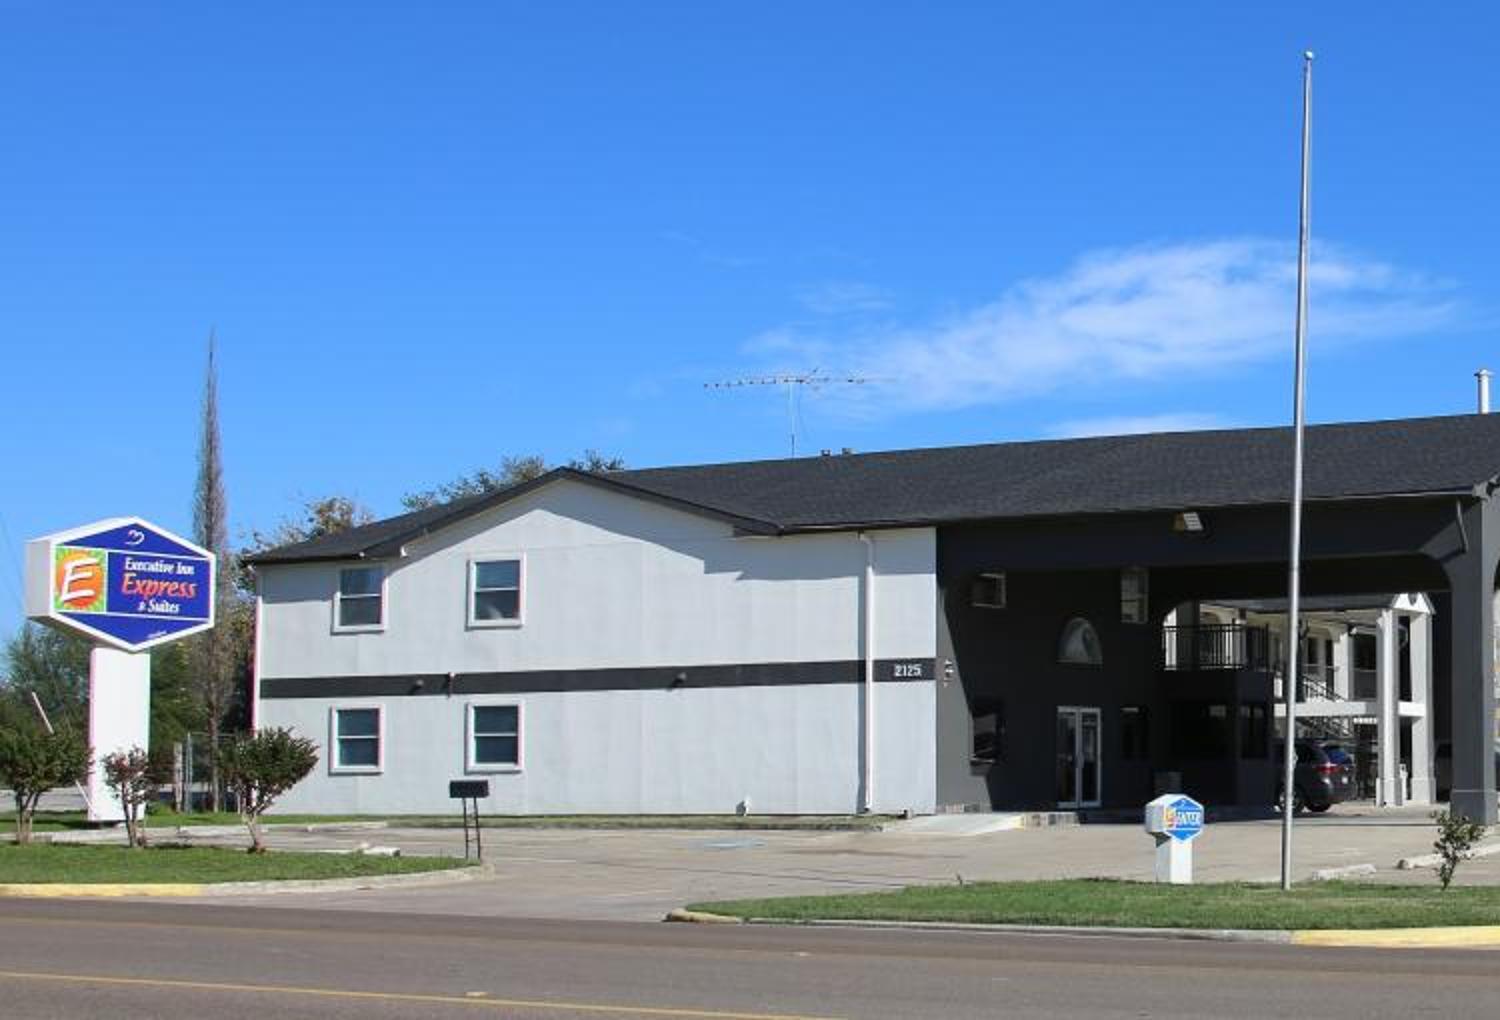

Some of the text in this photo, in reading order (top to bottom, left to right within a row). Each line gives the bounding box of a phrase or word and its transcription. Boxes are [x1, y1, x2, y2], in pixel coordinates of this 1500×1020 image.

[125, 557, 194, 575] Executive Inn
[61, 558, 99, 601] E
[122, 573, 197, 599] Express
[148, 600, 180, 613] Suites
[895, 664, 922, 677] 2125
